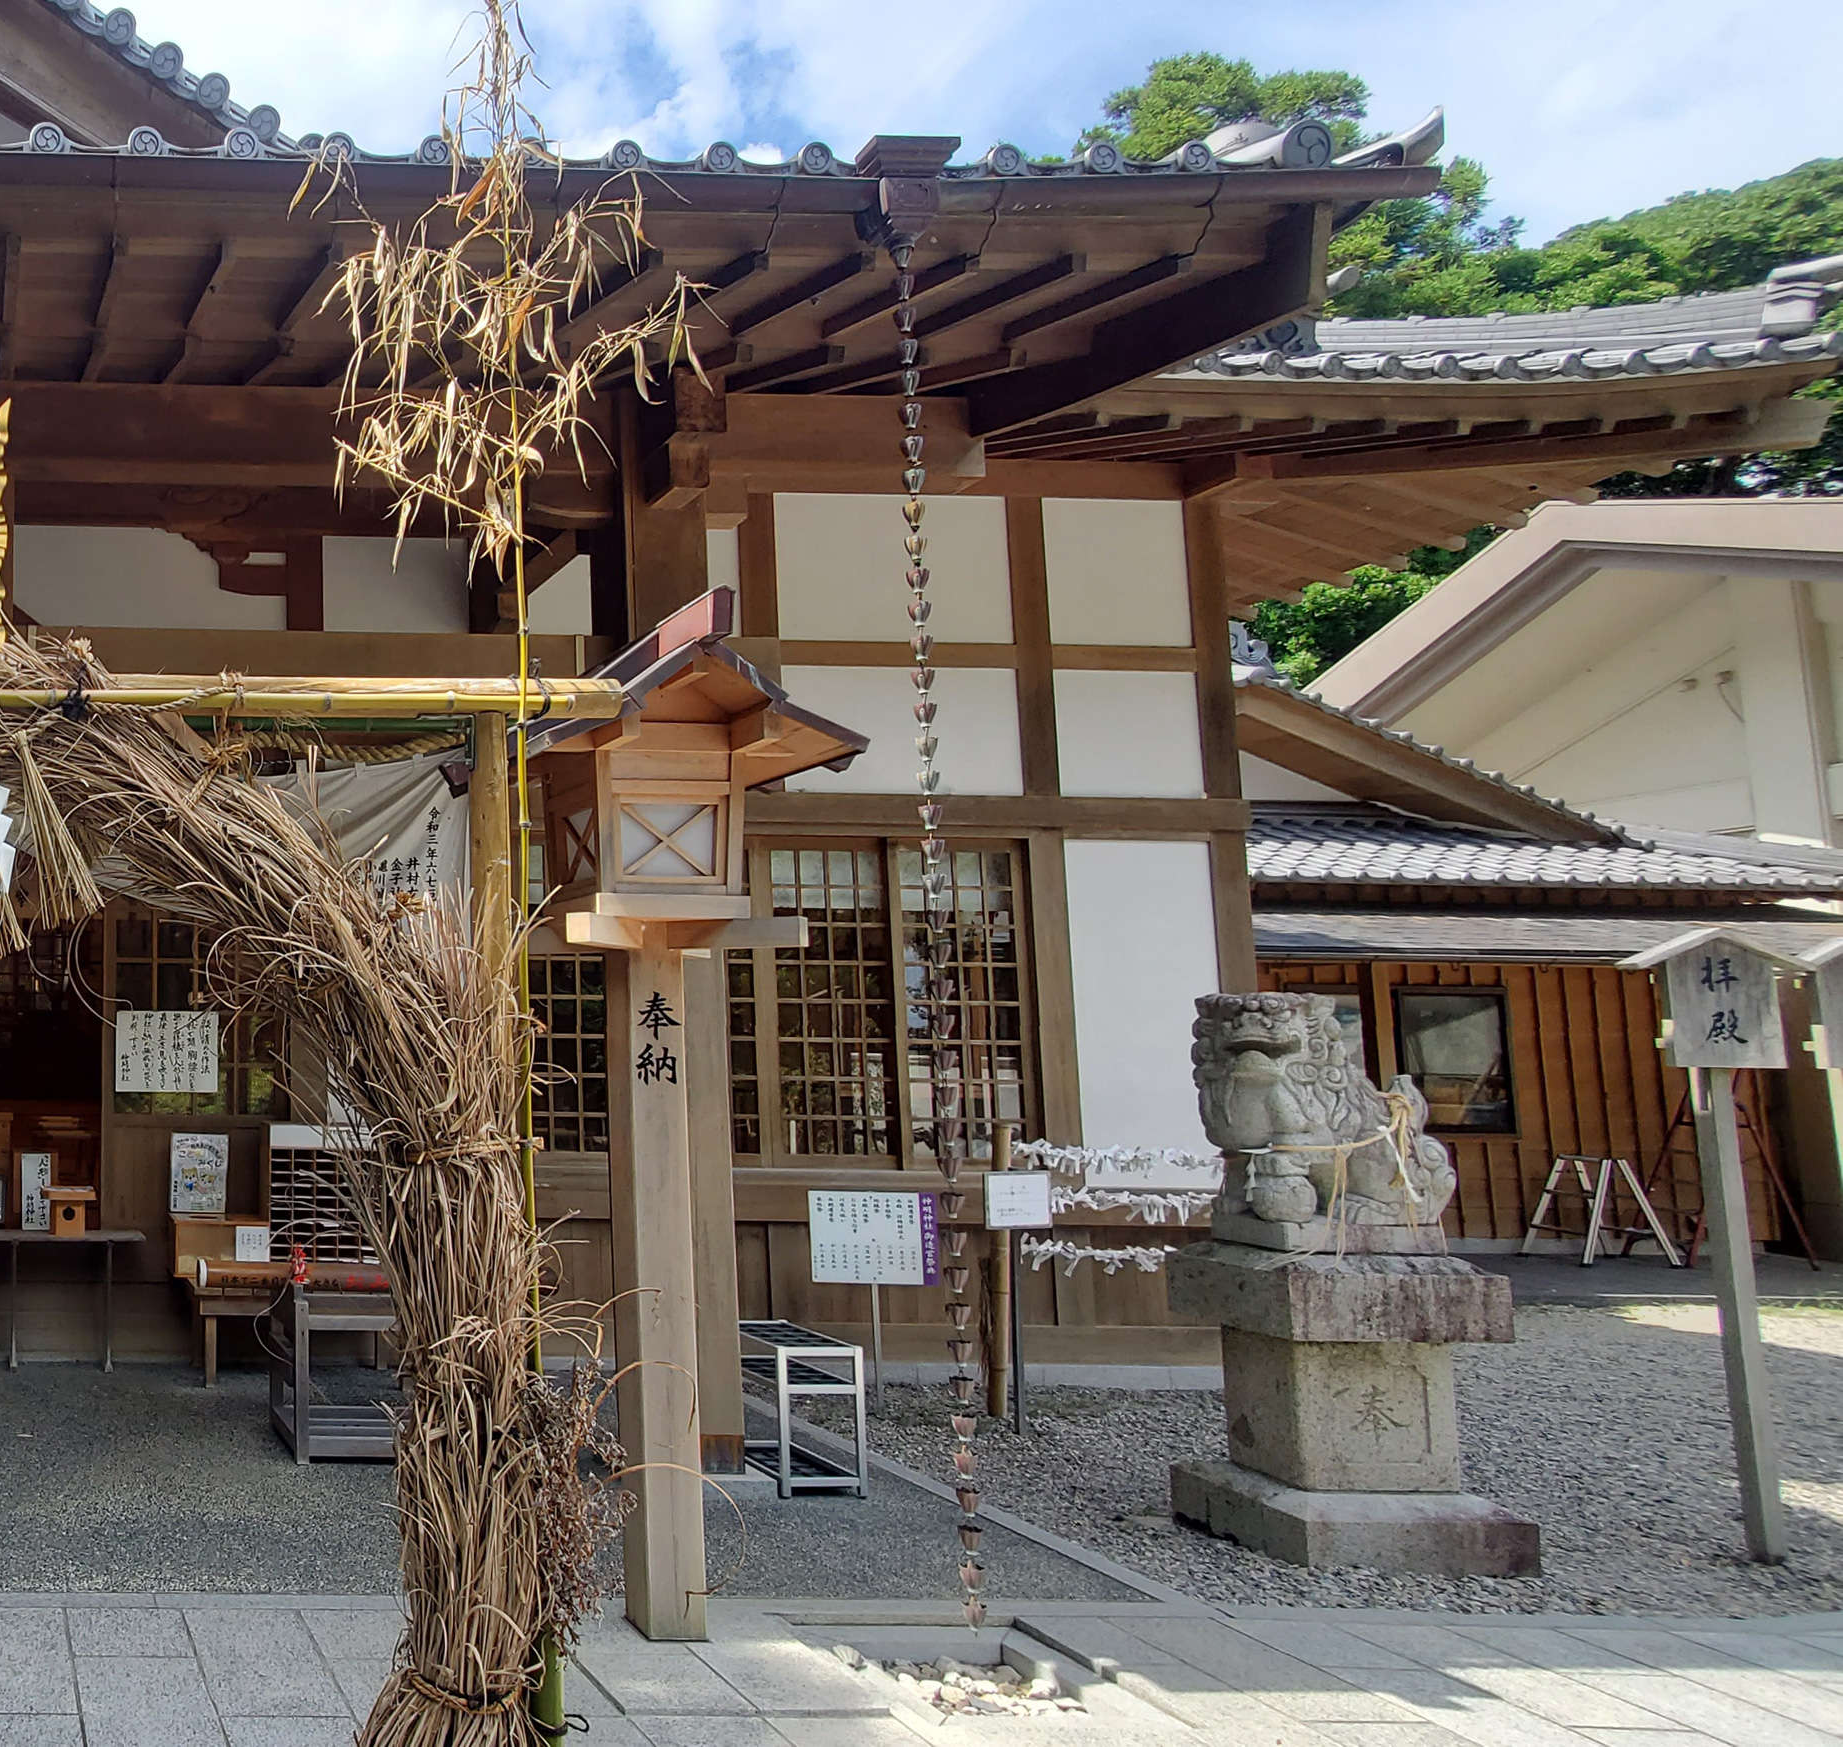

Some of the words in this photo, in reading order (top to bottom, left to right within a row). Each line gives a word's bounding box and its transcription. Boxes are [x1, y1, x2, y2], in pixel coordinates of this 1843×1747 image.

[636, 991, 681, 1085] 奉納
[1701, 957, 1748, 1044] 拝殿
[25, 1194, 35, 1224] 神明神社
